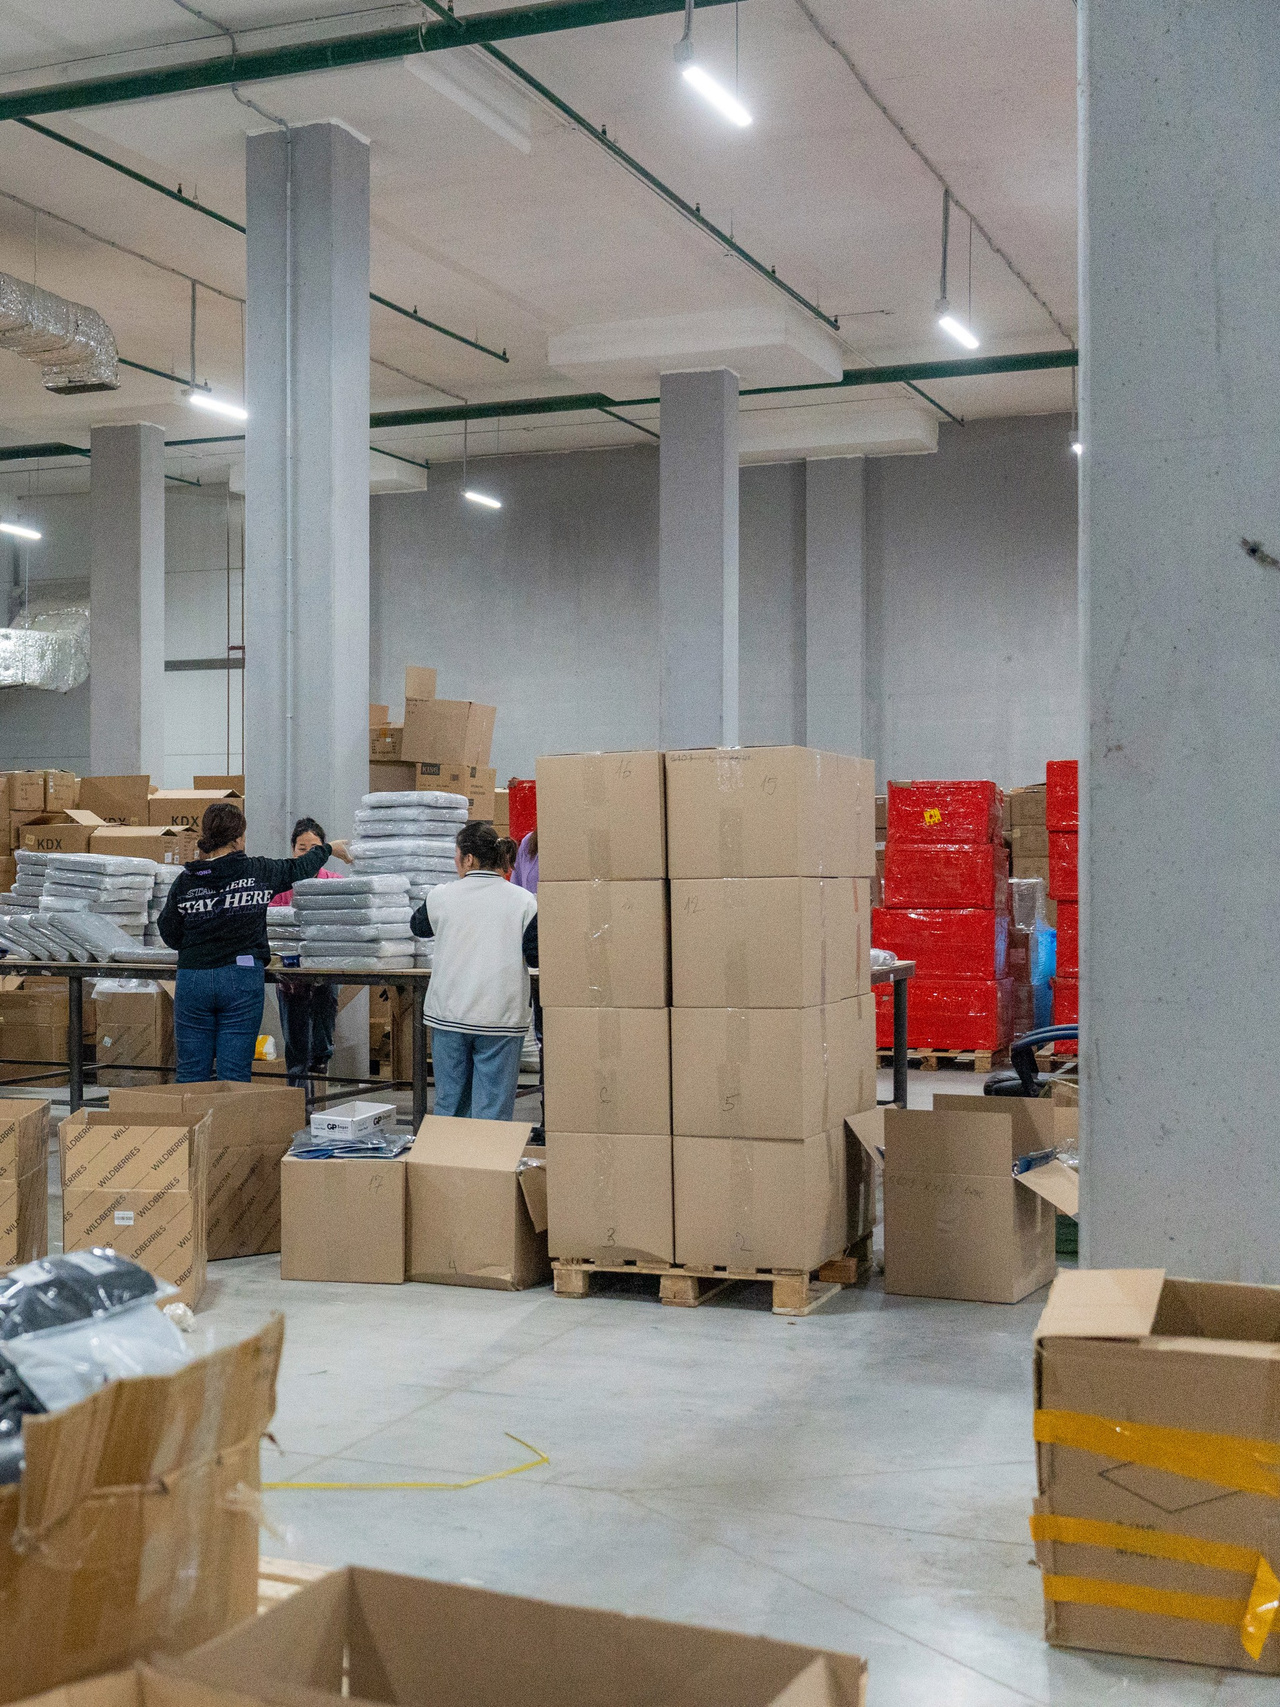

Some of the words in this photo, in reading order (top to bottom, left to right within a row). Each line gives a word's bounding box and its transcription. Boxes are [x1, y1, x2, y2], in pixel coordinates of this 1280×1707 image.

[172, 816, 199, 827] KDX
[37, 838, 62, 850] KDX
[223, 889, 273, 909] HERE
[722, 1092, 740, 1112] 5
[150, 1131, 189, 1172] WILDBERRIE
[97, 1146, 141, 1188] WILDBERRIES
[137, 1176, 180, 1219] WILDBERRIES
[83, 1194, 127, 1236] WILDBERRIES
[601, 1227, 616, 1248] 3
[735, 1231, 753, 1252] 2
[448, 1260, 458, 1275] 4
